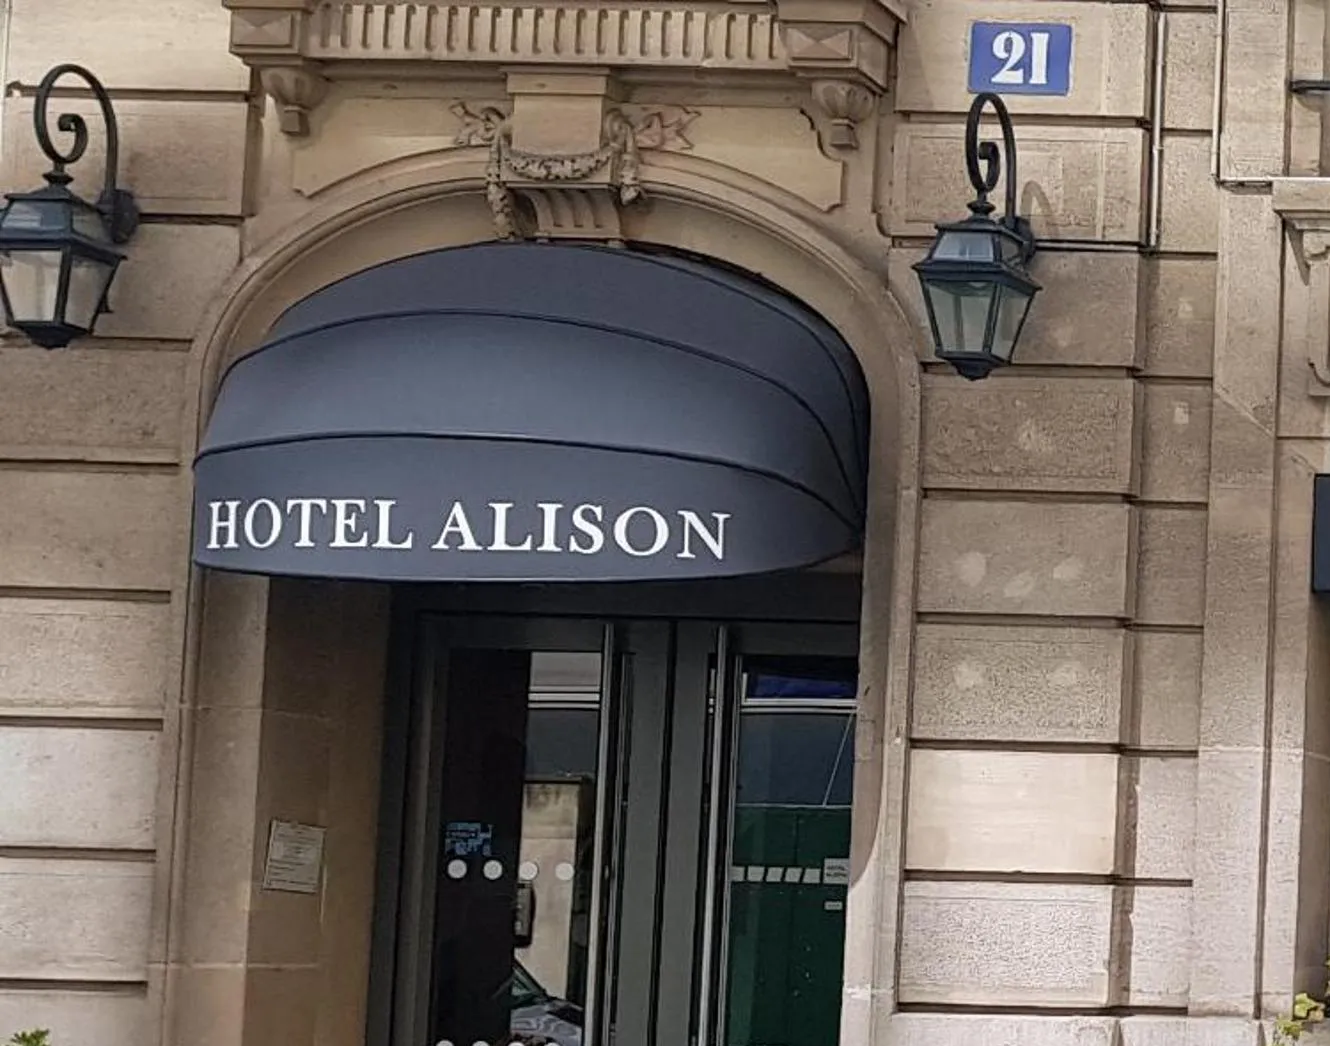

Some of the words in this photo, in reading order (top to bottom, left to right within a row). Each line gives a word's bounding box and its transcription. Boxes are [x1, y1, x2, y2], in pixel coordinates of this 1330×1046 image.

[991, 30, 1049, 84] 21
[205, 498, 413, 549] HOTEL
[431, 500, 731, 560] ALISON
